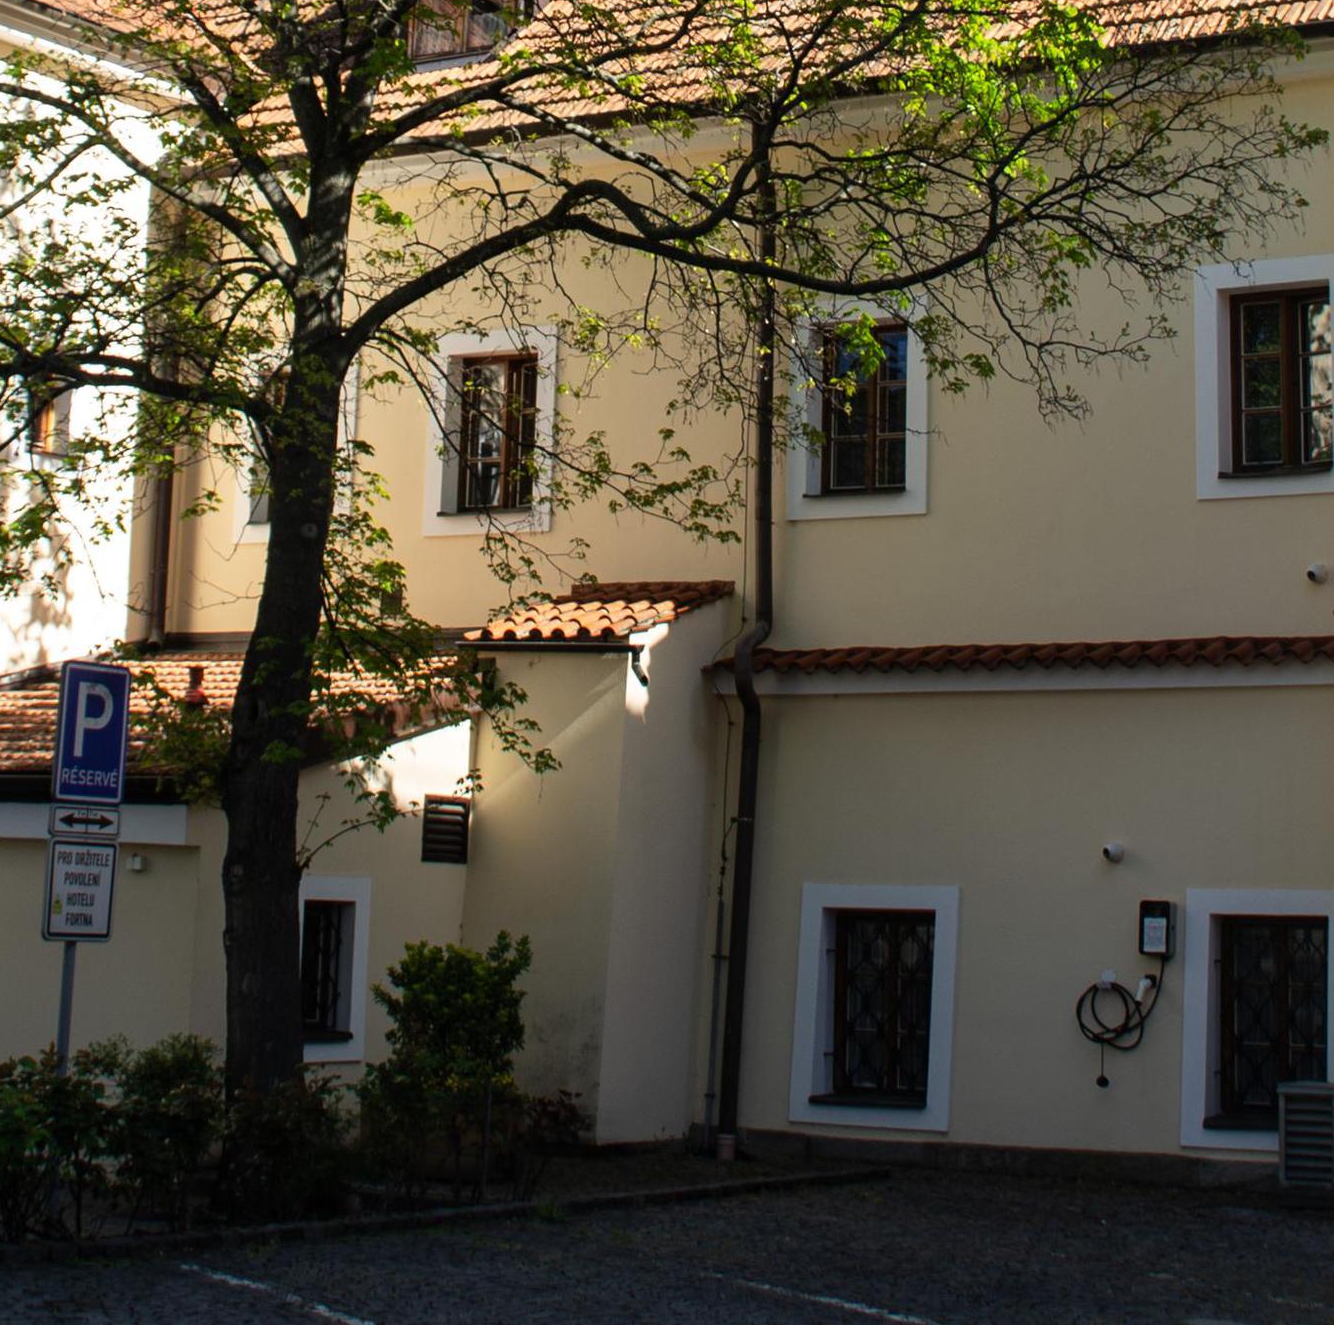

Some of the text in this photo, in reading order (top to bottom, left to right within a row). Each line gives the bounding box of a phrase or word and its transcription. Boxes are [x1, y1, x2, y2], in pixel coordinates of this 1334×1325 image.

[73, 681, 114, 757] P
[61, 766, 118, 788] RÉSERVÉ
[58, 849, 110, 867] PRO DRŽITELE
[64, 870, 101, 886] POVOLENÍ
[66, 892, 95, 907] HOTELU
[66, 912, 93, 926] FORTNA
